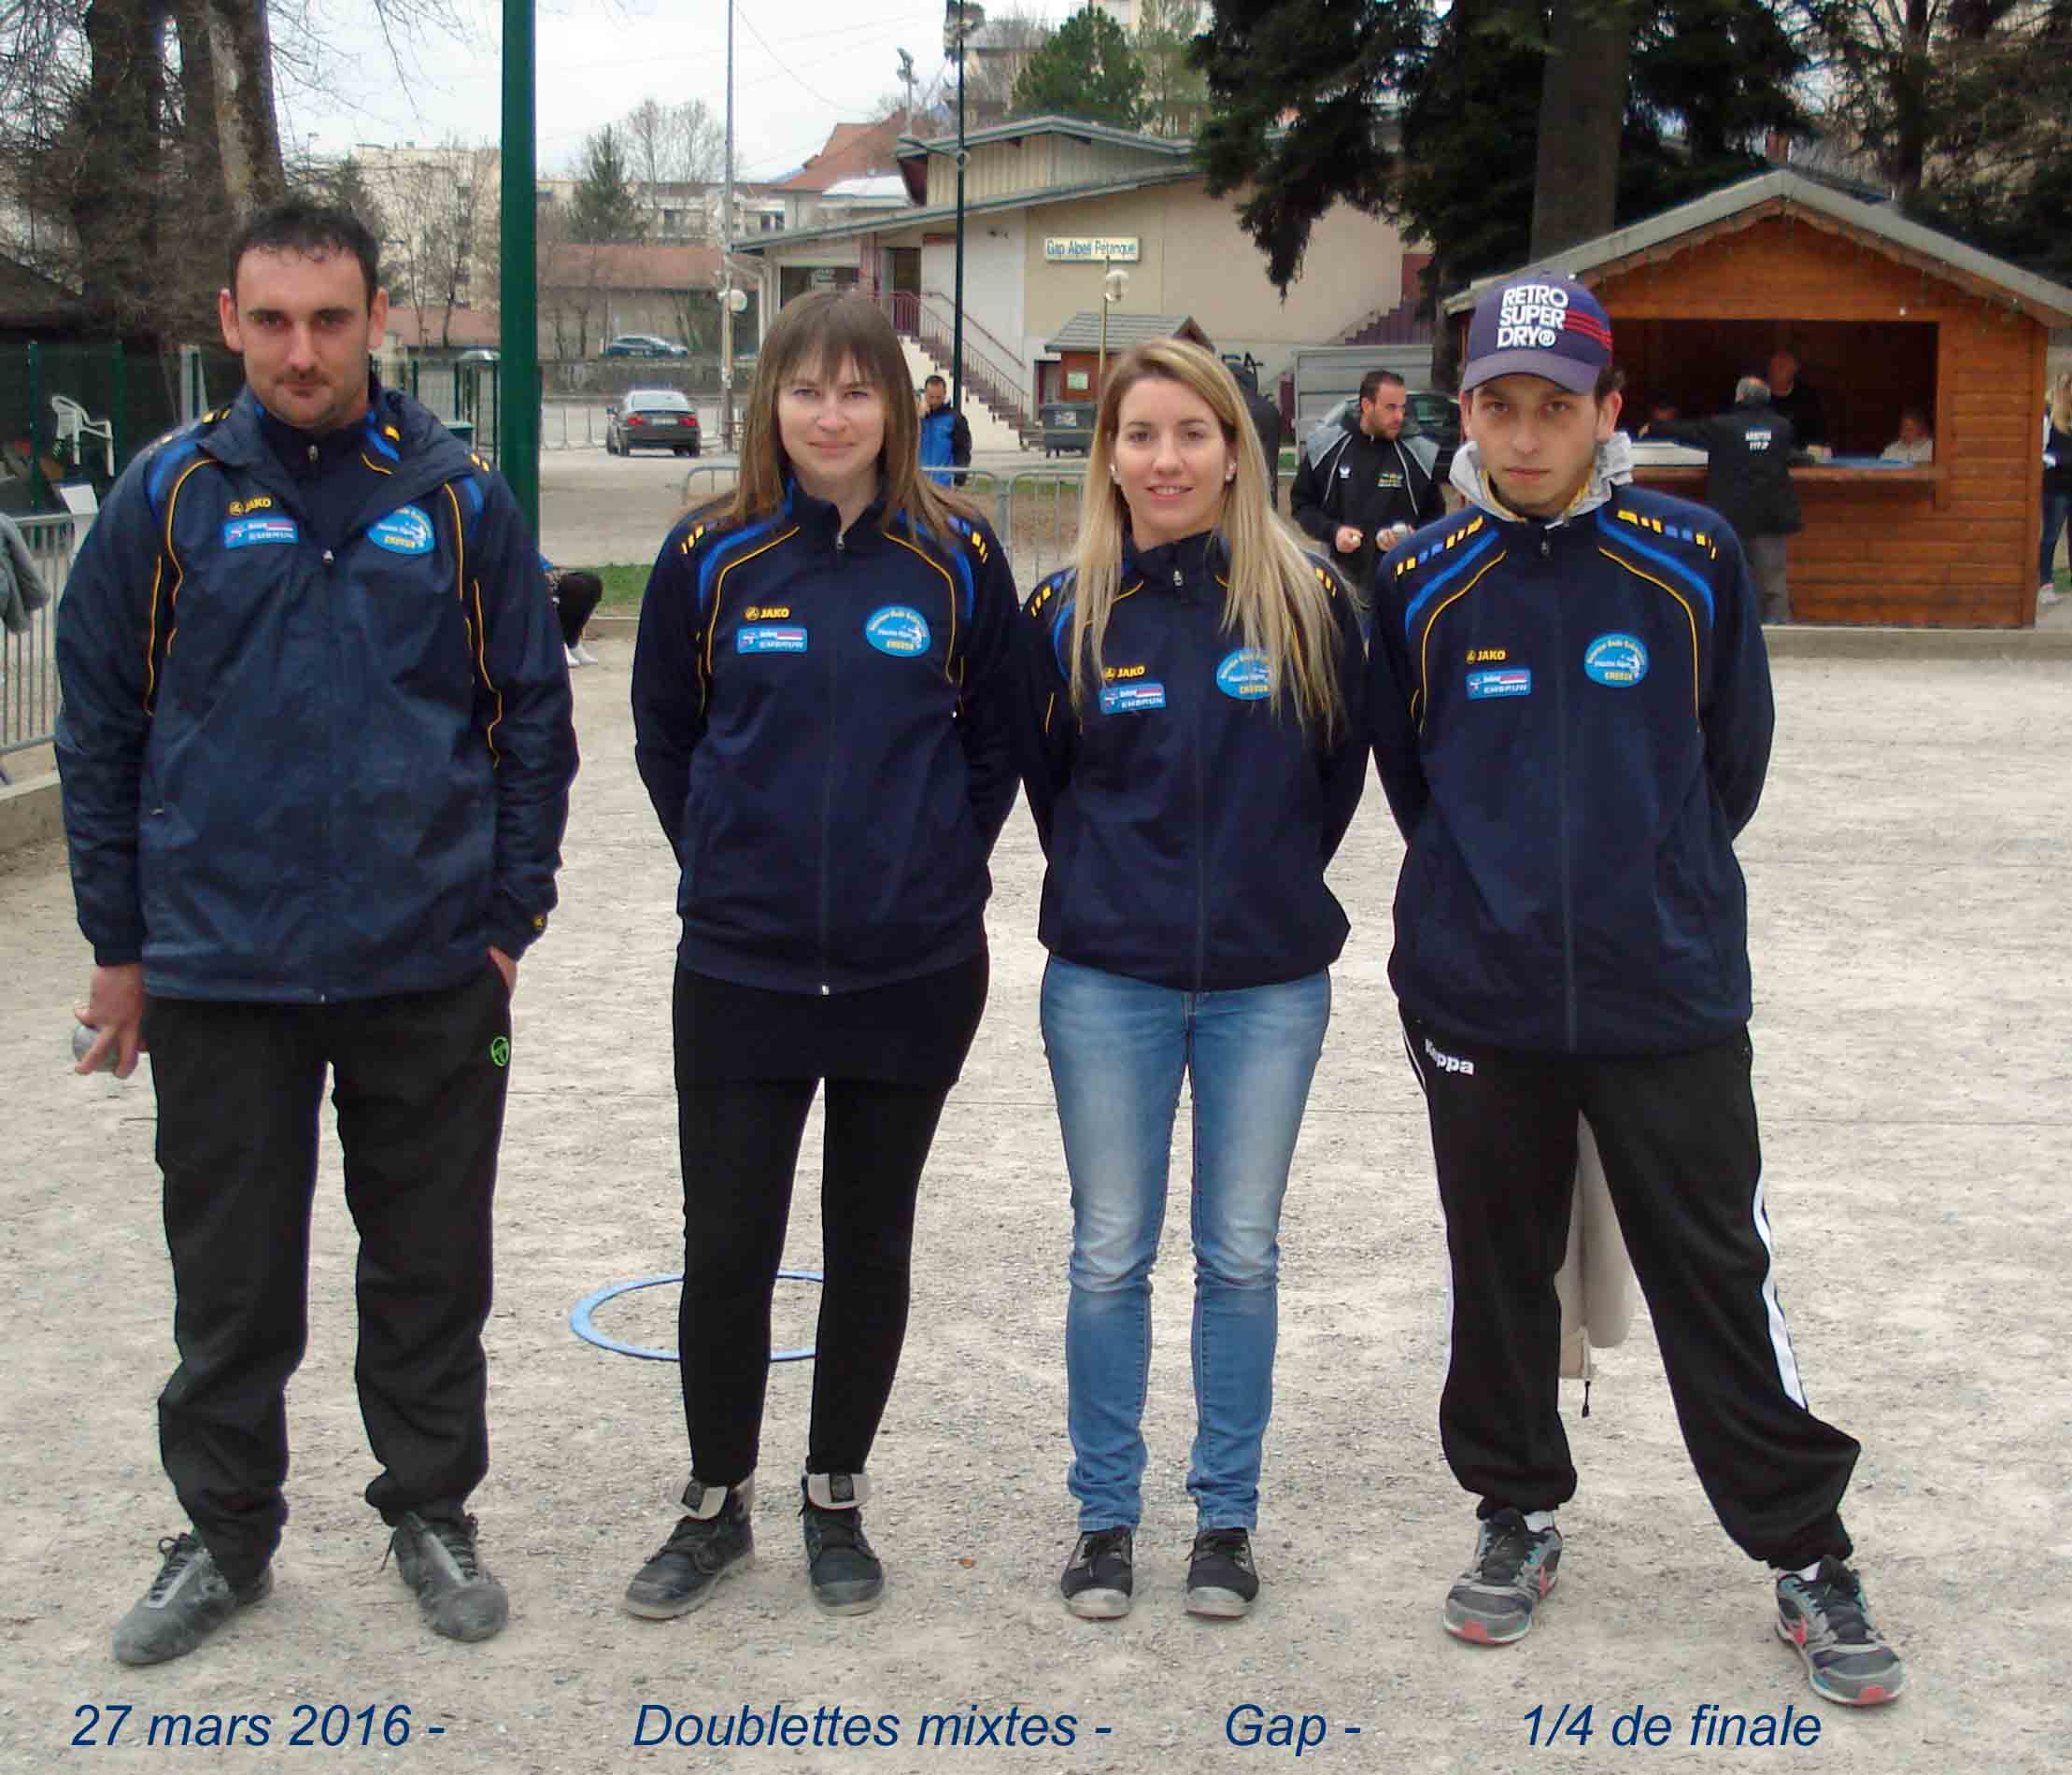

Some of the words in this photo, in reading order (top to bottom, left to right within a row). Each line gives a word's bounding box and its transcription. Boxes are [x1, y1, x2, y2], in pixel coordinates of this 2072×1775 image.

[1046, 239, 1065, 257] Gap
[1502, 285, 1568, 309] RETRO
[1499, 305, 1566, 330] SUPER
[760, 606, 790, 619] JAKO
[1478, 648, 1507, 661] JAKO
[1117, 665, 1145, 679] JAKO
